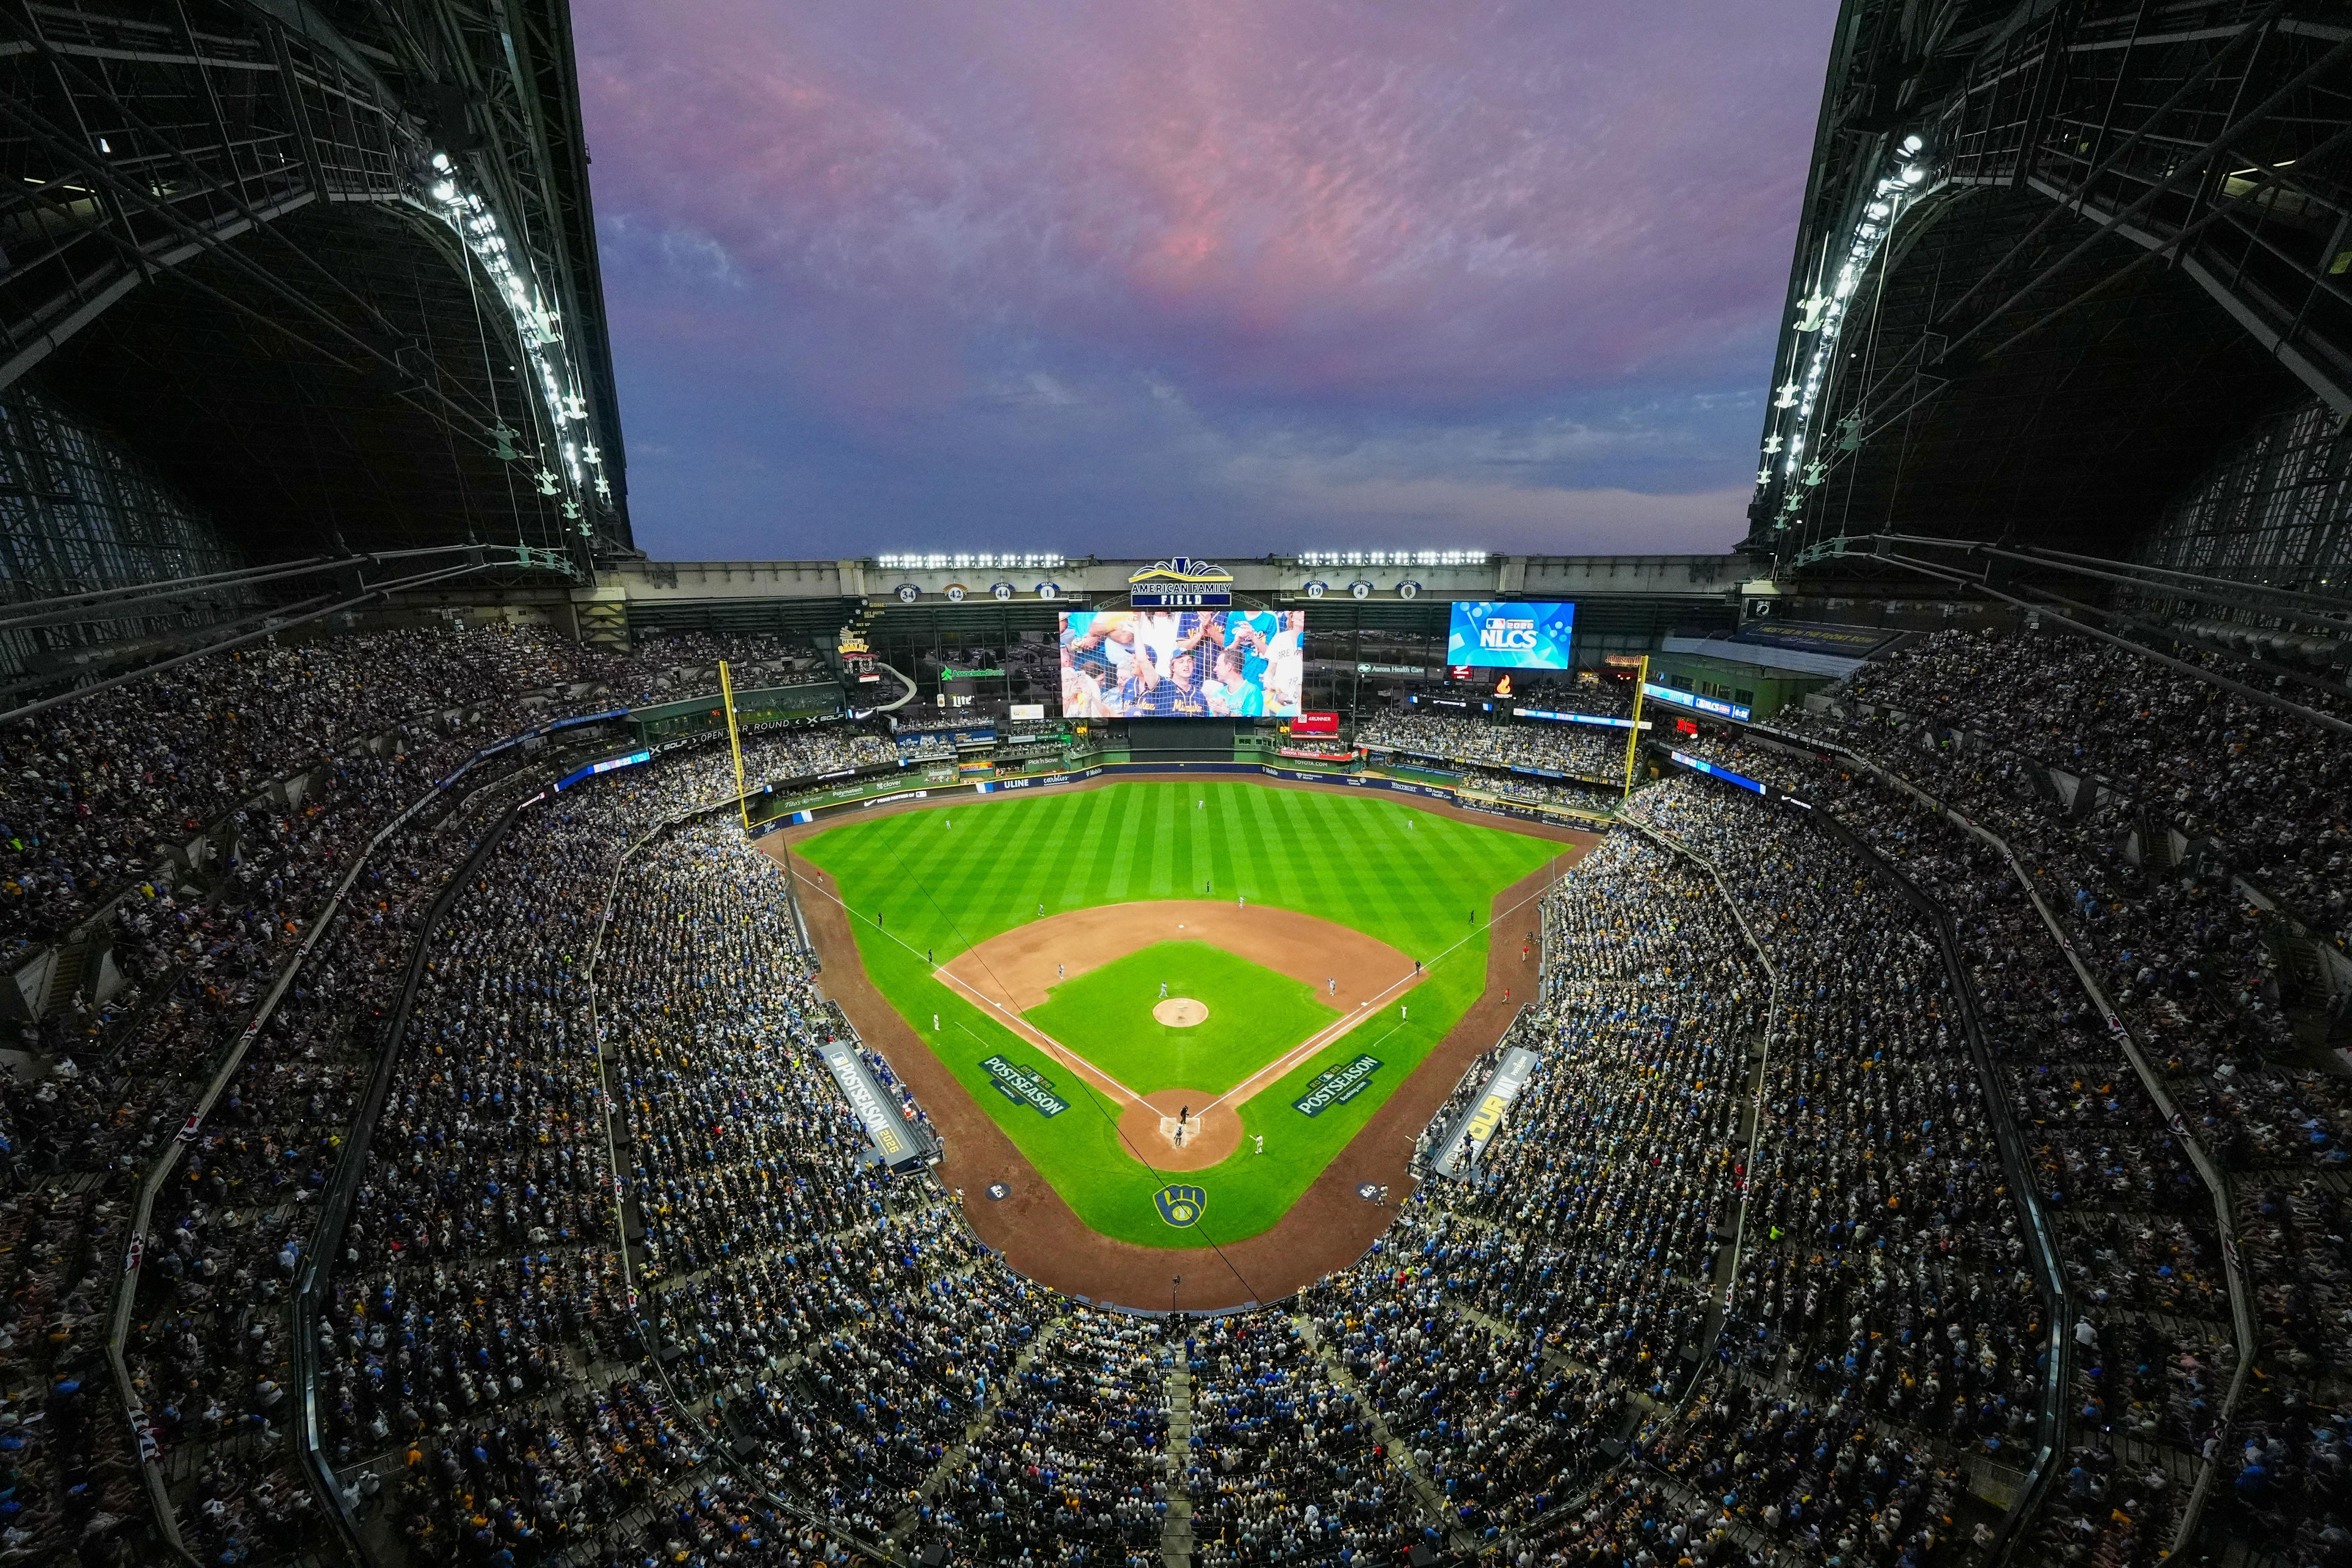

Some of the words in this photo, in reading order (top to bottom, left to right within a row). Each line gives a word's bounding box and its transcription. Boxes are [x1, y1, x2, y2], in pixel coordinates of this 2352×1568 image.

[1132, 583, 1188, 593] AMERICAN
[1192, 583, 1231, 593] FAMILY
[1310, 587, 1321, 596] 19
[902, 591, 914, 599] 34
[951, 590, 961, 598] 42
[997, 589, 1009, 598] 44
[1161, 594, 1202, 604] FIELD
[1480, 630, 1538, 648] NLCS
[838, 644, 869, 654] CHALET
[649, 745, 662, 755] X
[664, 739, 688, 750] GOLF
[701, 731, 723, 743] OPEN
[726, 725, 748, 736] YAR
[754, 720, 790, 731] ROUND
[820, 713, 844, 721] GOLF
[1266, 767, 1278, 776] Mobile
[1004, 779, 1028, 788] ULINE
[1391, 782, 1418, 792] WINTRUST
[833, 787, 863, 797] Polymatech
[785, 799, 801, 809] Tito's
[1510, 1055, 1528, 1076] POSTSEASON
[984, 1056, 1065, 1116] POSTSEASON
[1297, 1055, 1379, 1114] POSTSEASON
[1339, 1080, 1367, 1102] Booking.com
[836, 1062, 890, 1133] POSTSEASON
[879, 1130, 900, 1153] 2026
[1469, 1095, 1509, 1141] OUR
[1491, 1075, 1520, 1099] WAY
[990, 1185, 1004, 1198] NLCS
